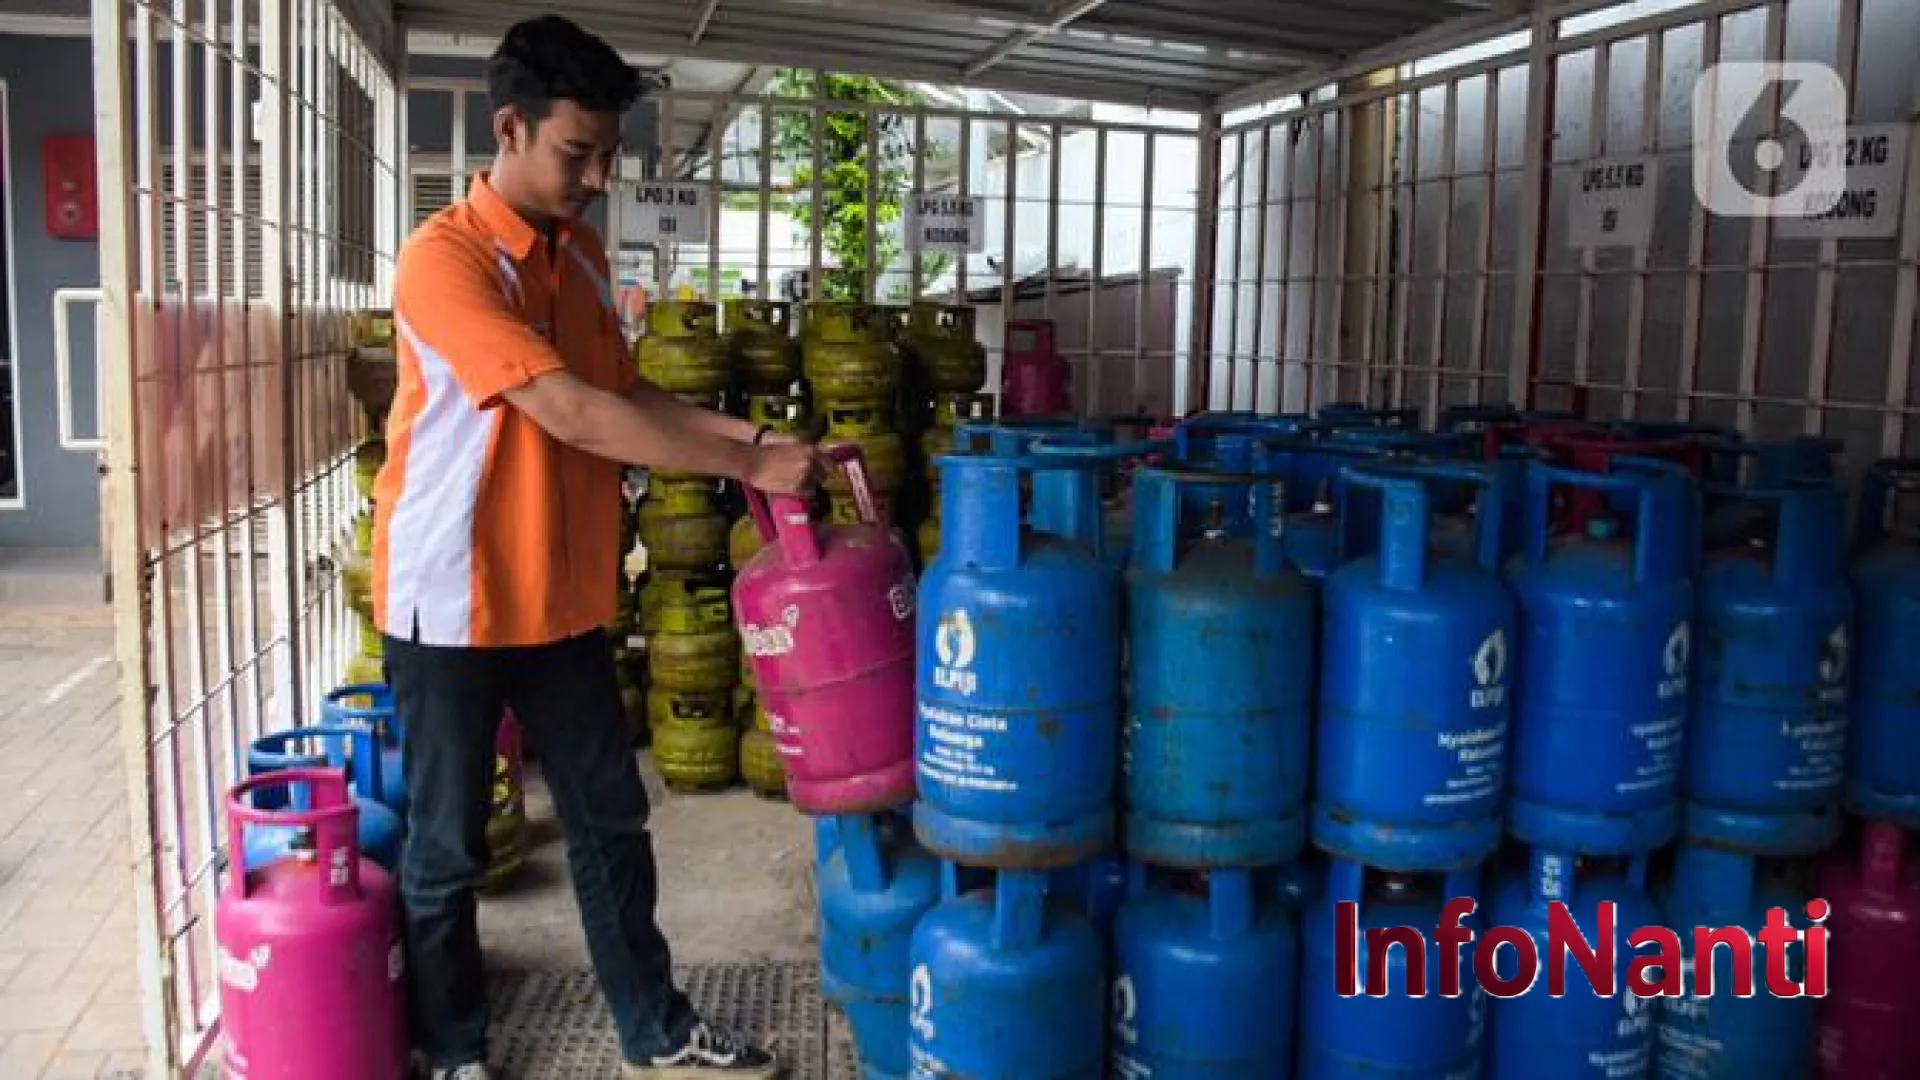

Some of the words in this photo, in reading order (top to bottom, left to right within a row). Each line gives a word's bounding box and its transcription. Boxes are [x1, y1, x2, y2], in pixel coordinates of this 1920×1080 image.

[1860, 134, 1888, 165] KG
[1625, 163, 1644, 188] KG
[636, 185, 662, 205] LPG
[678, 188, 697, 206] KG
[1803, 188, 1877, 221] KOSONG
